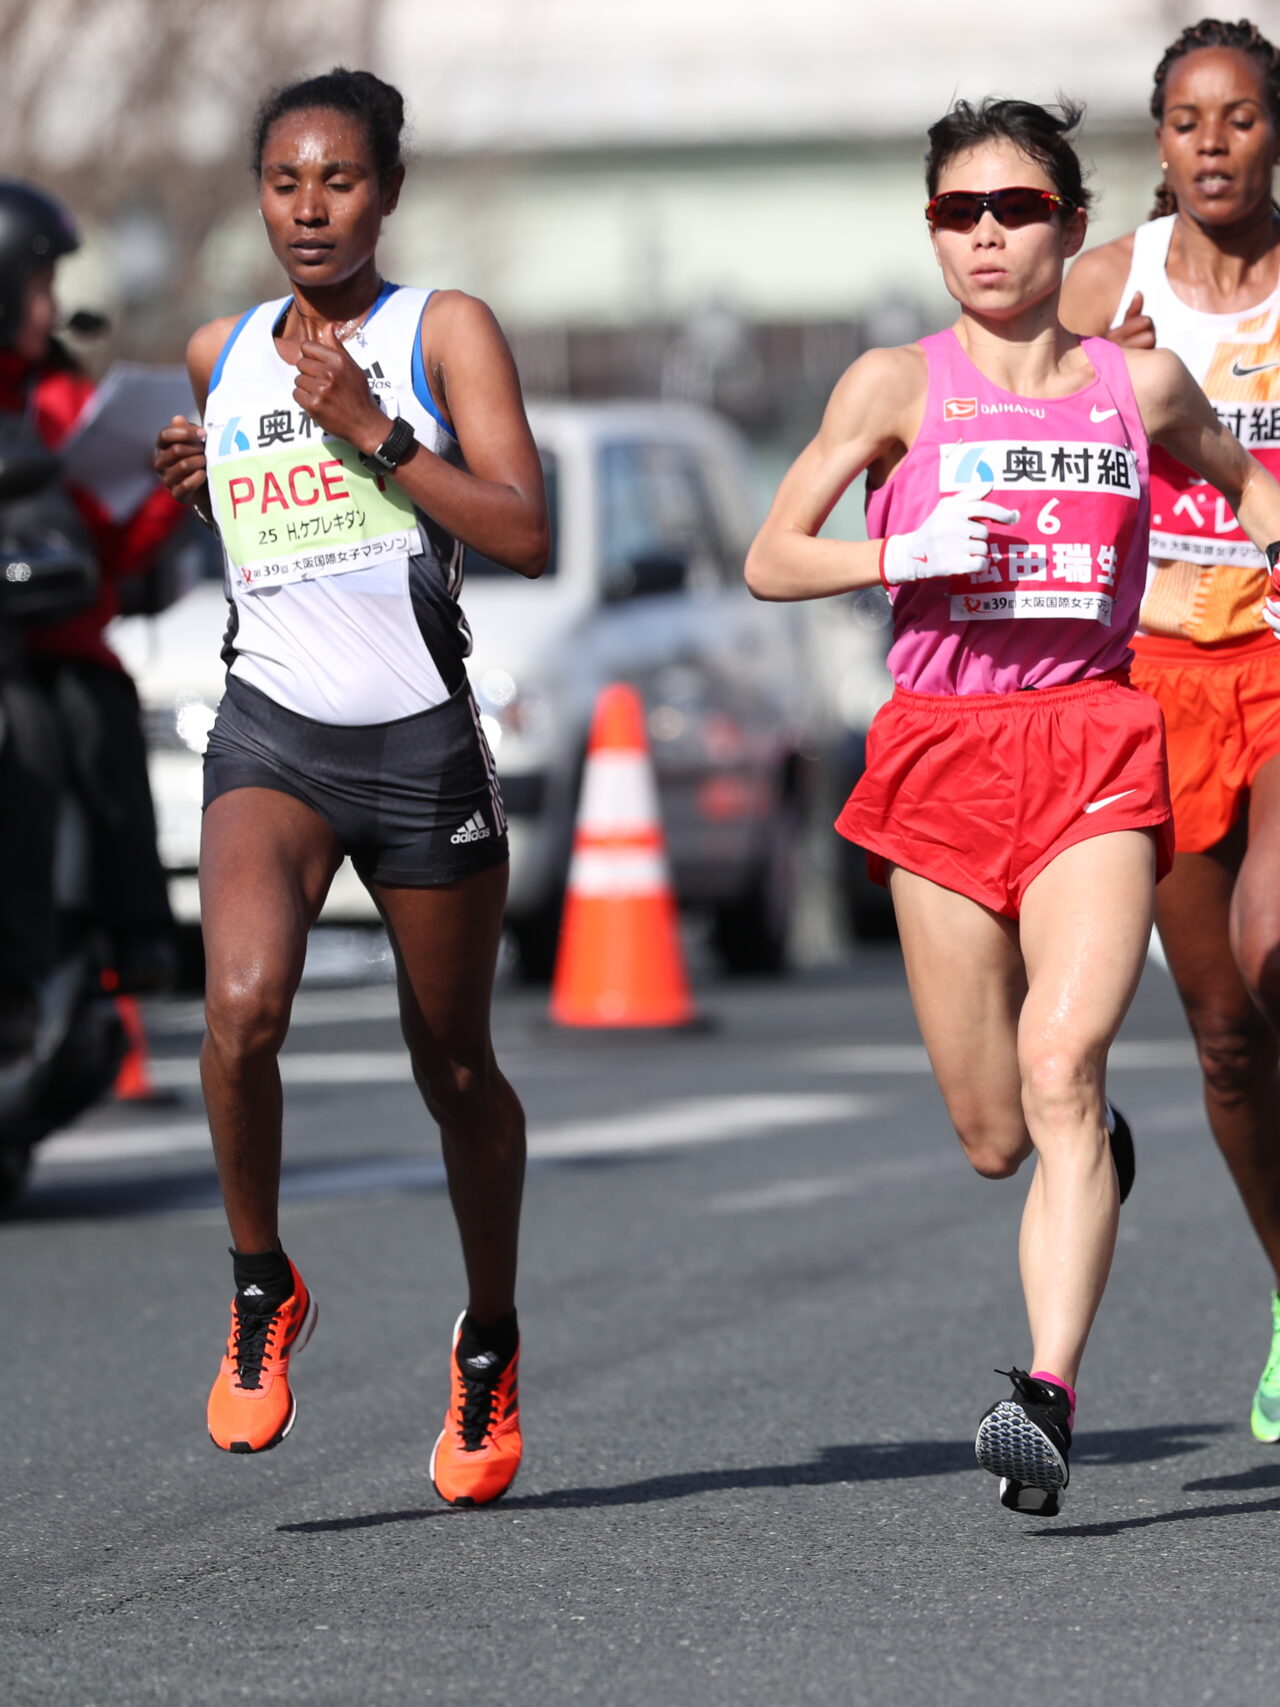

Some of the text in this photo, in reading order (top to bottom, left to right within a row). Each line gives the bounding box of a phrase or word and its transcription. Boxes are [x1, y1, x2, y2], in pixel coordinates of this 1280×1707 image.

[980, 402, 1045, 419] DAIHATSU
[1002, 445, 1132, 490] 奥村組
[228, 458, 350, 519] PACE
[1036, 497, 1062, 536] 6
[258, 528, 279, 546] 25
[291, 536, 408, 571] 大阪国際女子マラソン
[450, 828, 490, 844] adidas
